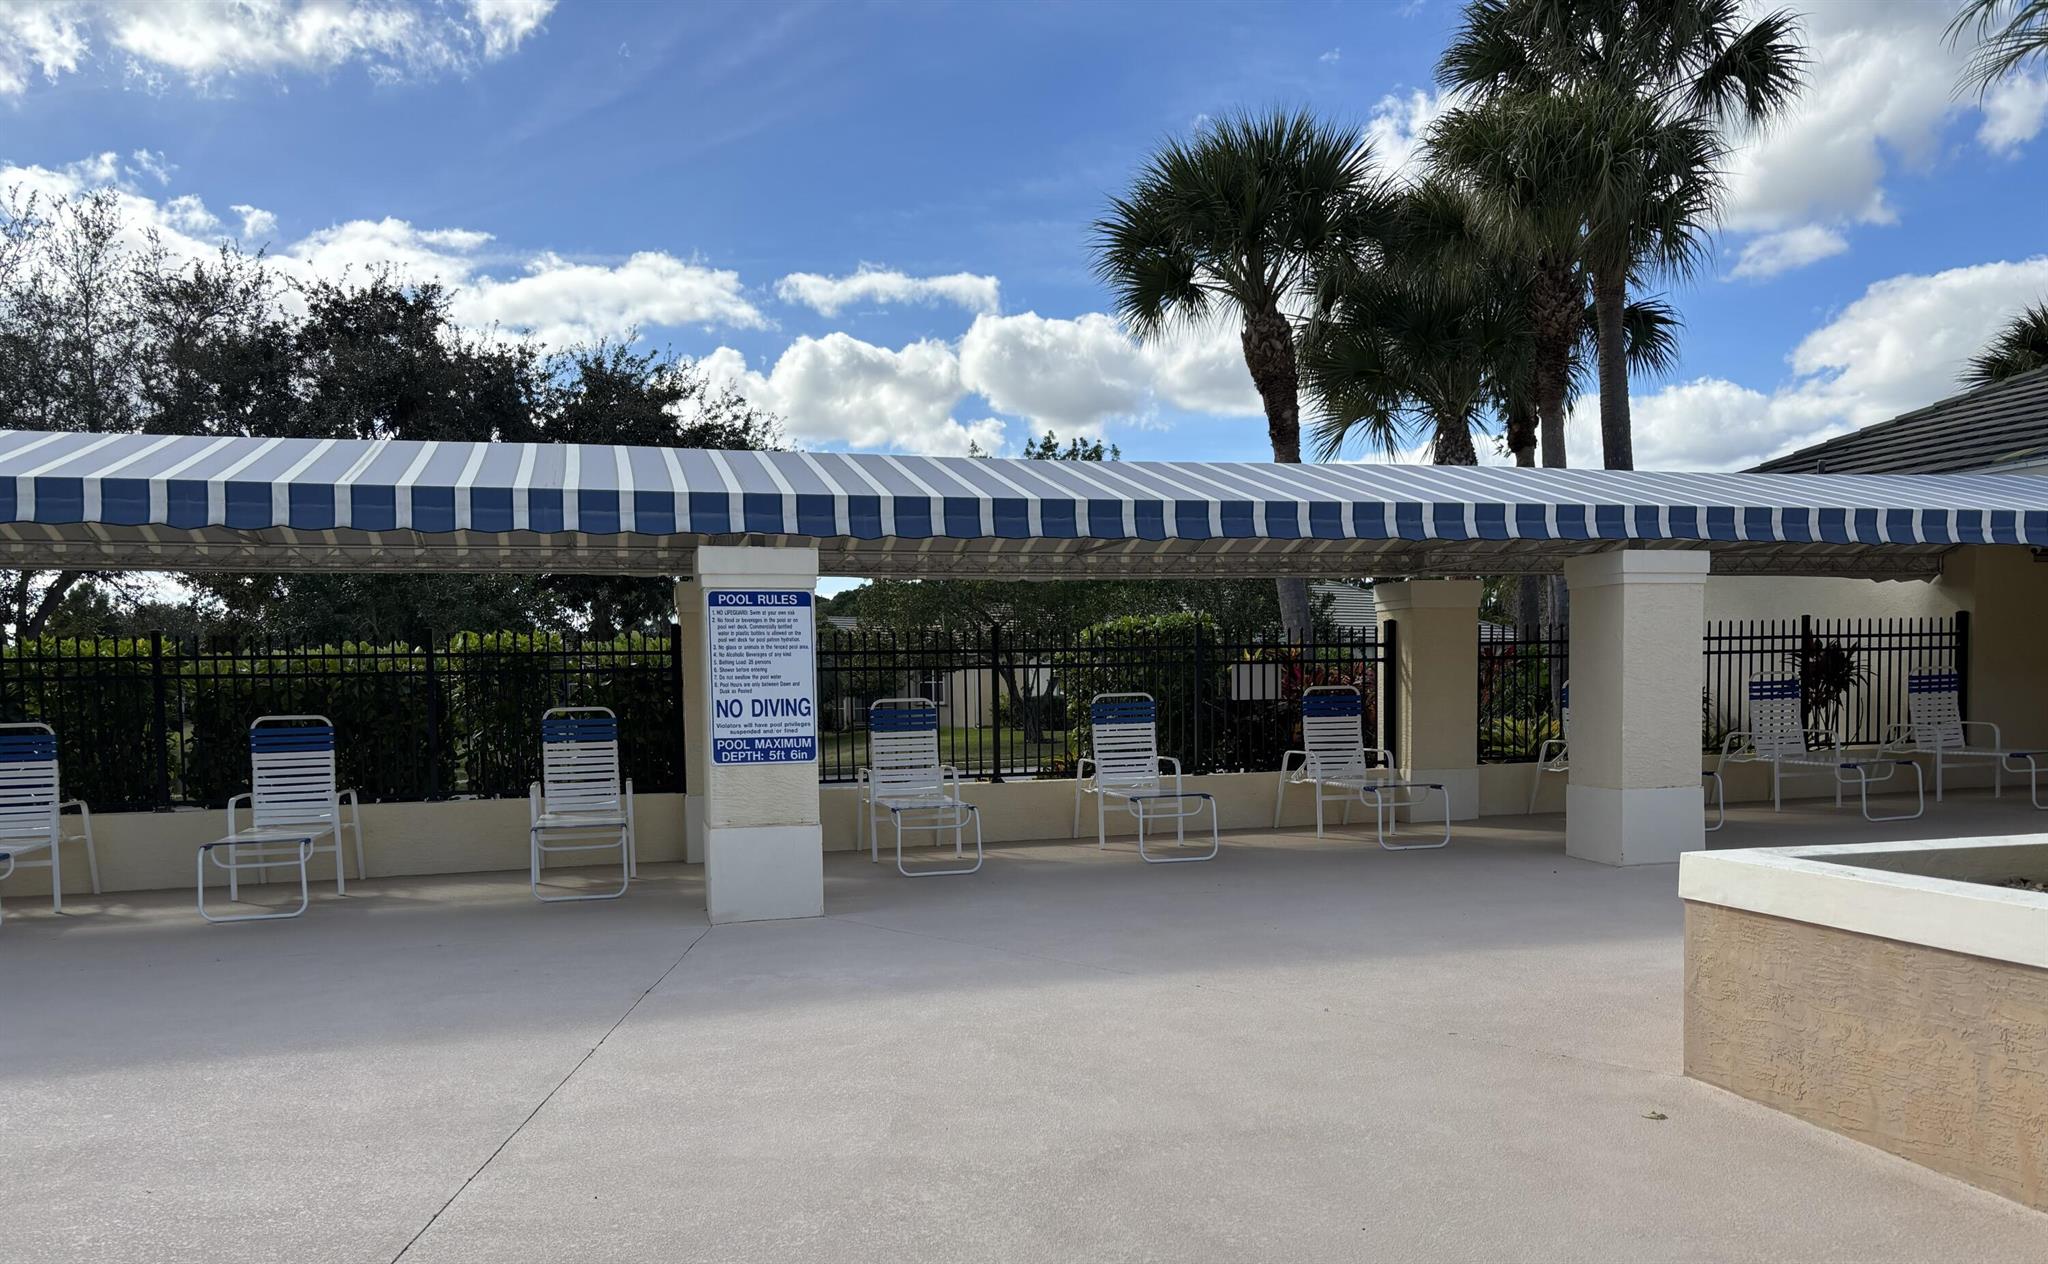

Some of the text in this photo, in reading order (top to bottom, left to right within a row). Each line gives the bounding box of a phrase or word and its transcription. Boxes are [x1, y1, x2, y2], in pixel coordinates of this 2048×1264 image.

[718, 594, 798, 605] POOL RULES
[716, 697, 811, 718] NO DIVING
[717, 738, 812, 750] POOL MAXIMUM
[722, 749, 808, 762] DEPTH: 5ft 6in
